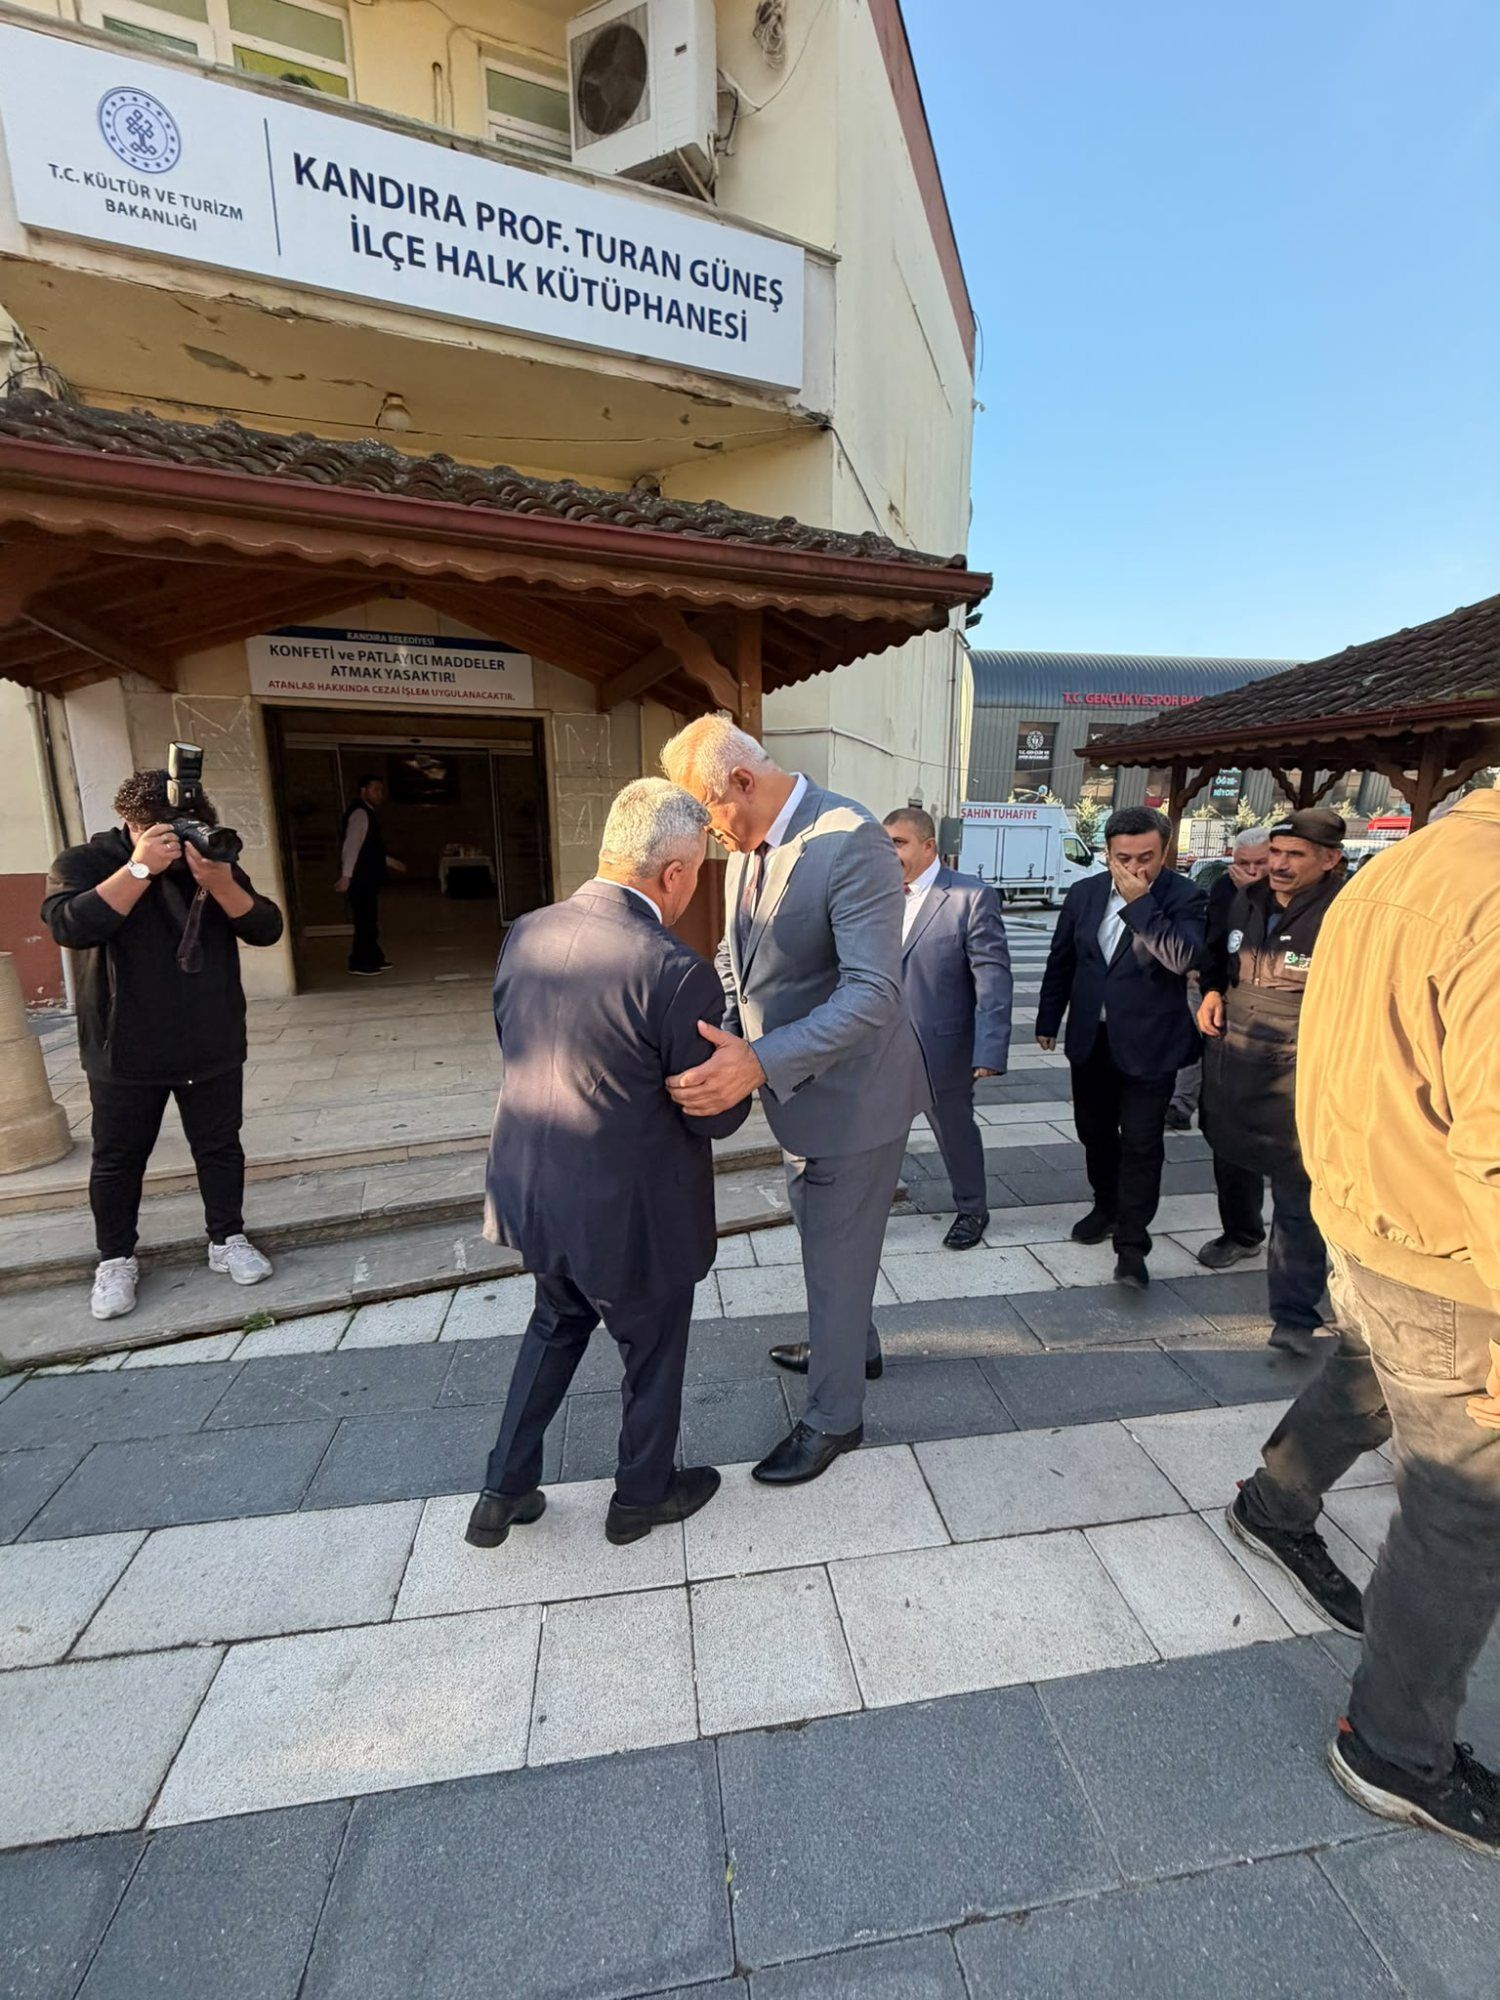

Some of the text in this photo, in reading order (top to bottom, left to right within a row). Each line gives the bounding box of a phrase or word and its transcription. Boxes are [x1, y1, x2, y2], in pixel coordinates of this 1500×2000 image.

[48, 163, 243, 221] T.C. KÜLTÜR VE TURİZM
[105, 198, 197, 232] BAKANLIĞI
[293, 152, 784, 313] KANDIRA PROF. TURAN GÜNEŞ
[350, 214, 747, 343] İLÇE HALK KÜTÜPHANESİ
[346, 631, 435, 646] KANDIRA BELEDİYESİ
[269, 643, 505, 671] KONFETİ ve PATLAYICI MADDELER
[330, 665, 456, 683] ATMAK YASAKTIR!
[268, 680, 316, 691] ATANLAR
[317, 683, 370, 694] HAKKINDA
[401, 685, 430, 697] İŞLEM
[431, 689, 516, 701] UYGULANACAKTIR.
[1063, 692, 1084, 704] T.C.
[1085, 692, 1134, 708] GENÇLİK
[1134, 694, 1149, 705] VE
[1149, 695, 1179, 707] SPOR
